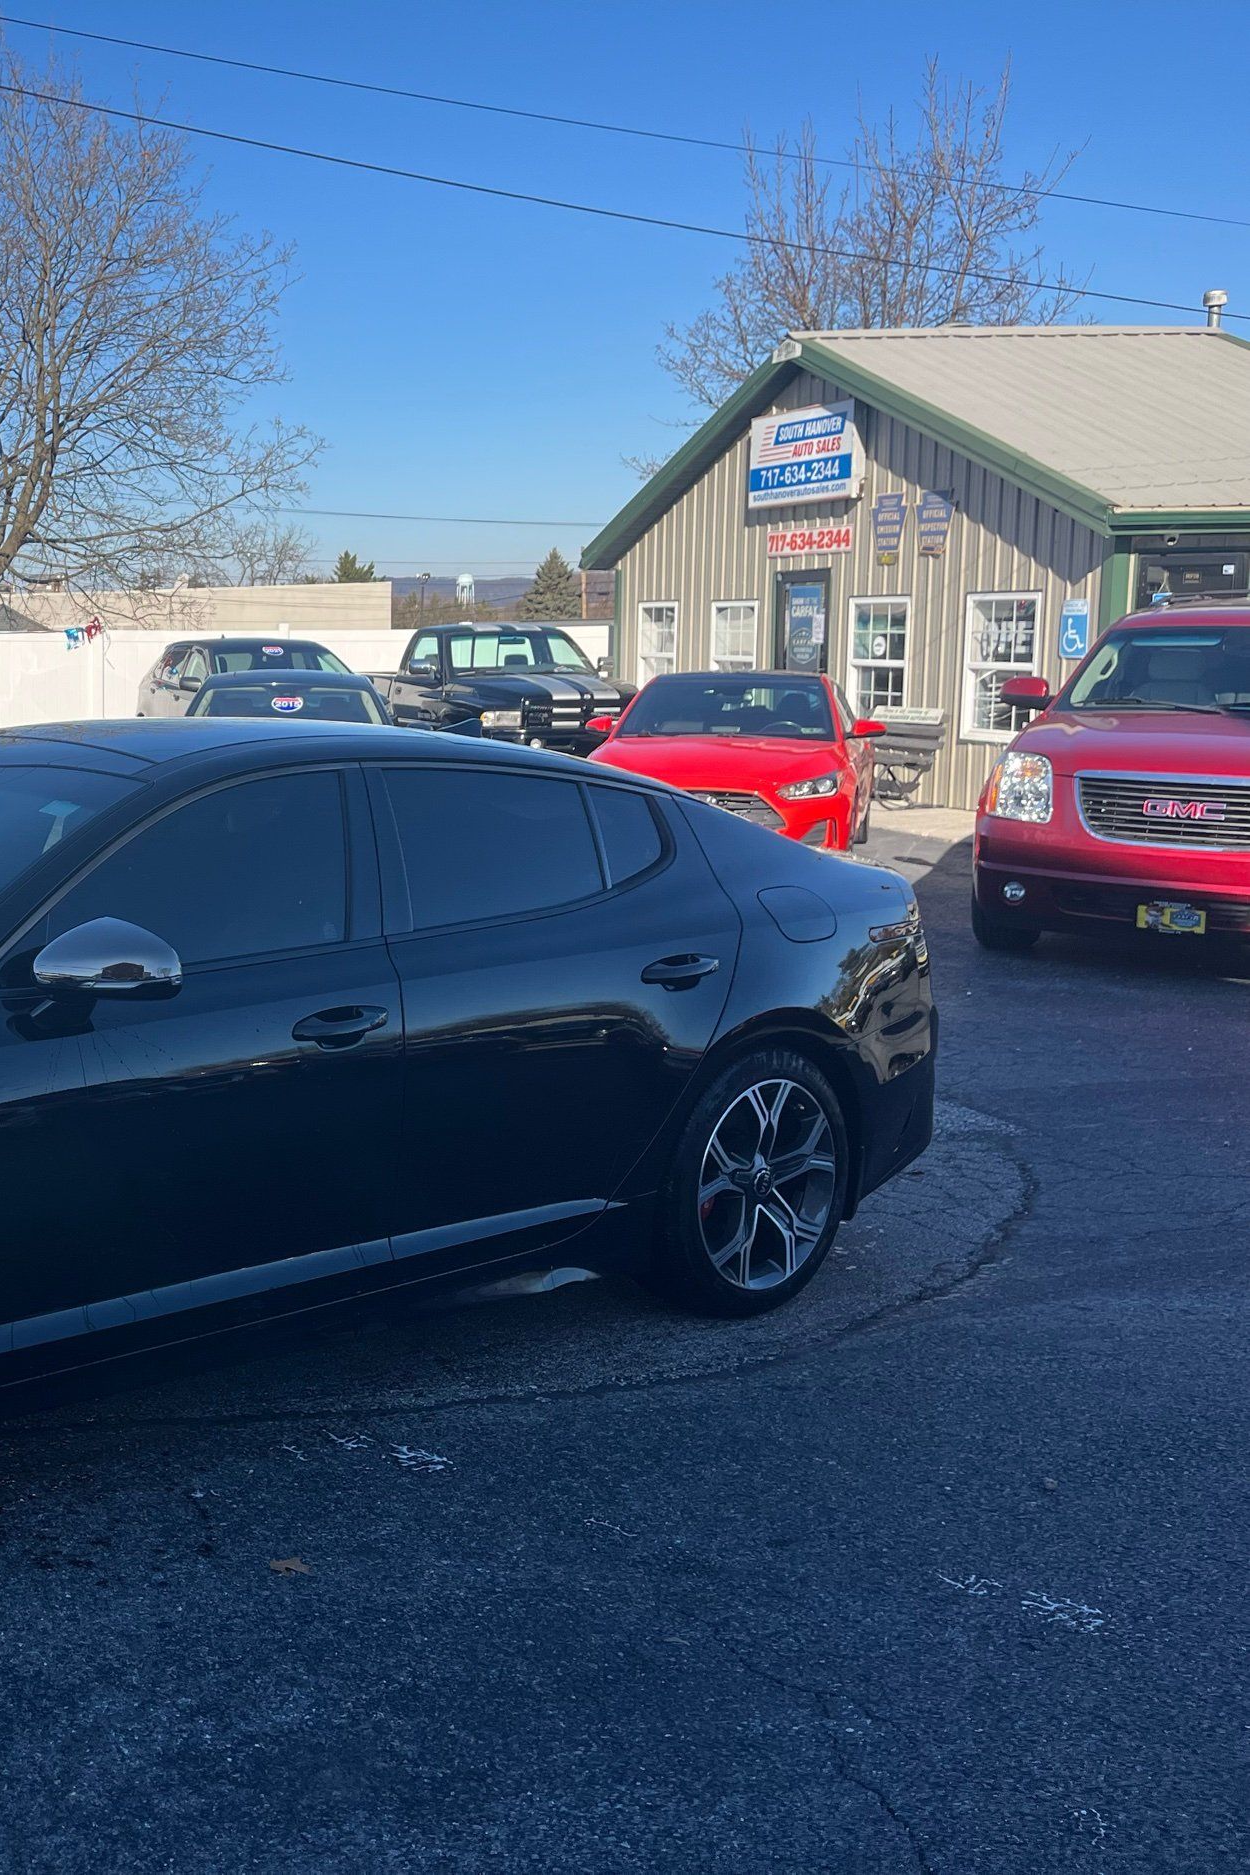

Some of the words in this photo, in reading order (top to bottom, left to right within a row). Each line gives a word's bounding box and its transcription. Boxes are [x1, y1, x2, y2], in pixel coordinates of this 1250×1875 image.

[778, 423, 804, 442] SOUTH
[804, 415, 842, 437] HANOVER
[791, 443, 814, 458] AUTO
[816, 436, 842, 454] SALES
[760, 458, 840, 488] 717-634-2344
[753, 482, 847, 503] southhanoverautosales.com
[877, 512, 900, 522] OFFICIAL
[922, 509, 947, 519] OFFICIAL
[768, 528, 850, 553] 717-634-2344
[1143, 799, 1227, 821] GMC
